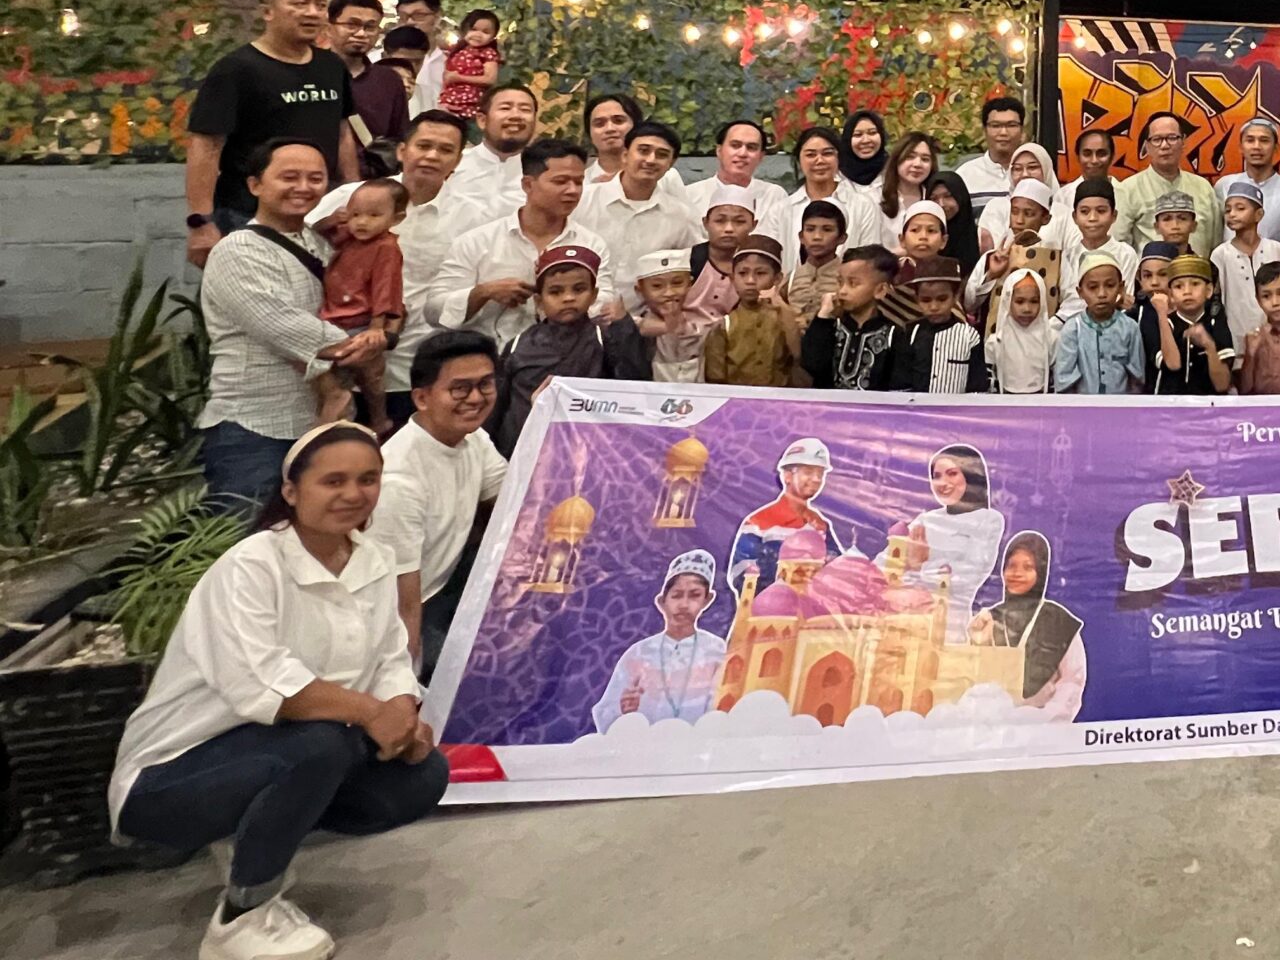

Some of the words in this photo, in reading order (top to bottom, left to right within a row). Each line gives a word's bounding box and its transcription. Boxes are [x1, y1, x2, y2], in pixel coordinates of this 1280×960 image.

[280, 89, 338, 103] WORLD
[1150, 608, 1264, 639] Semangat
[1085, 725, 1182, 746] Direktorat
[1186, 720, 1258, 739] Sumber
